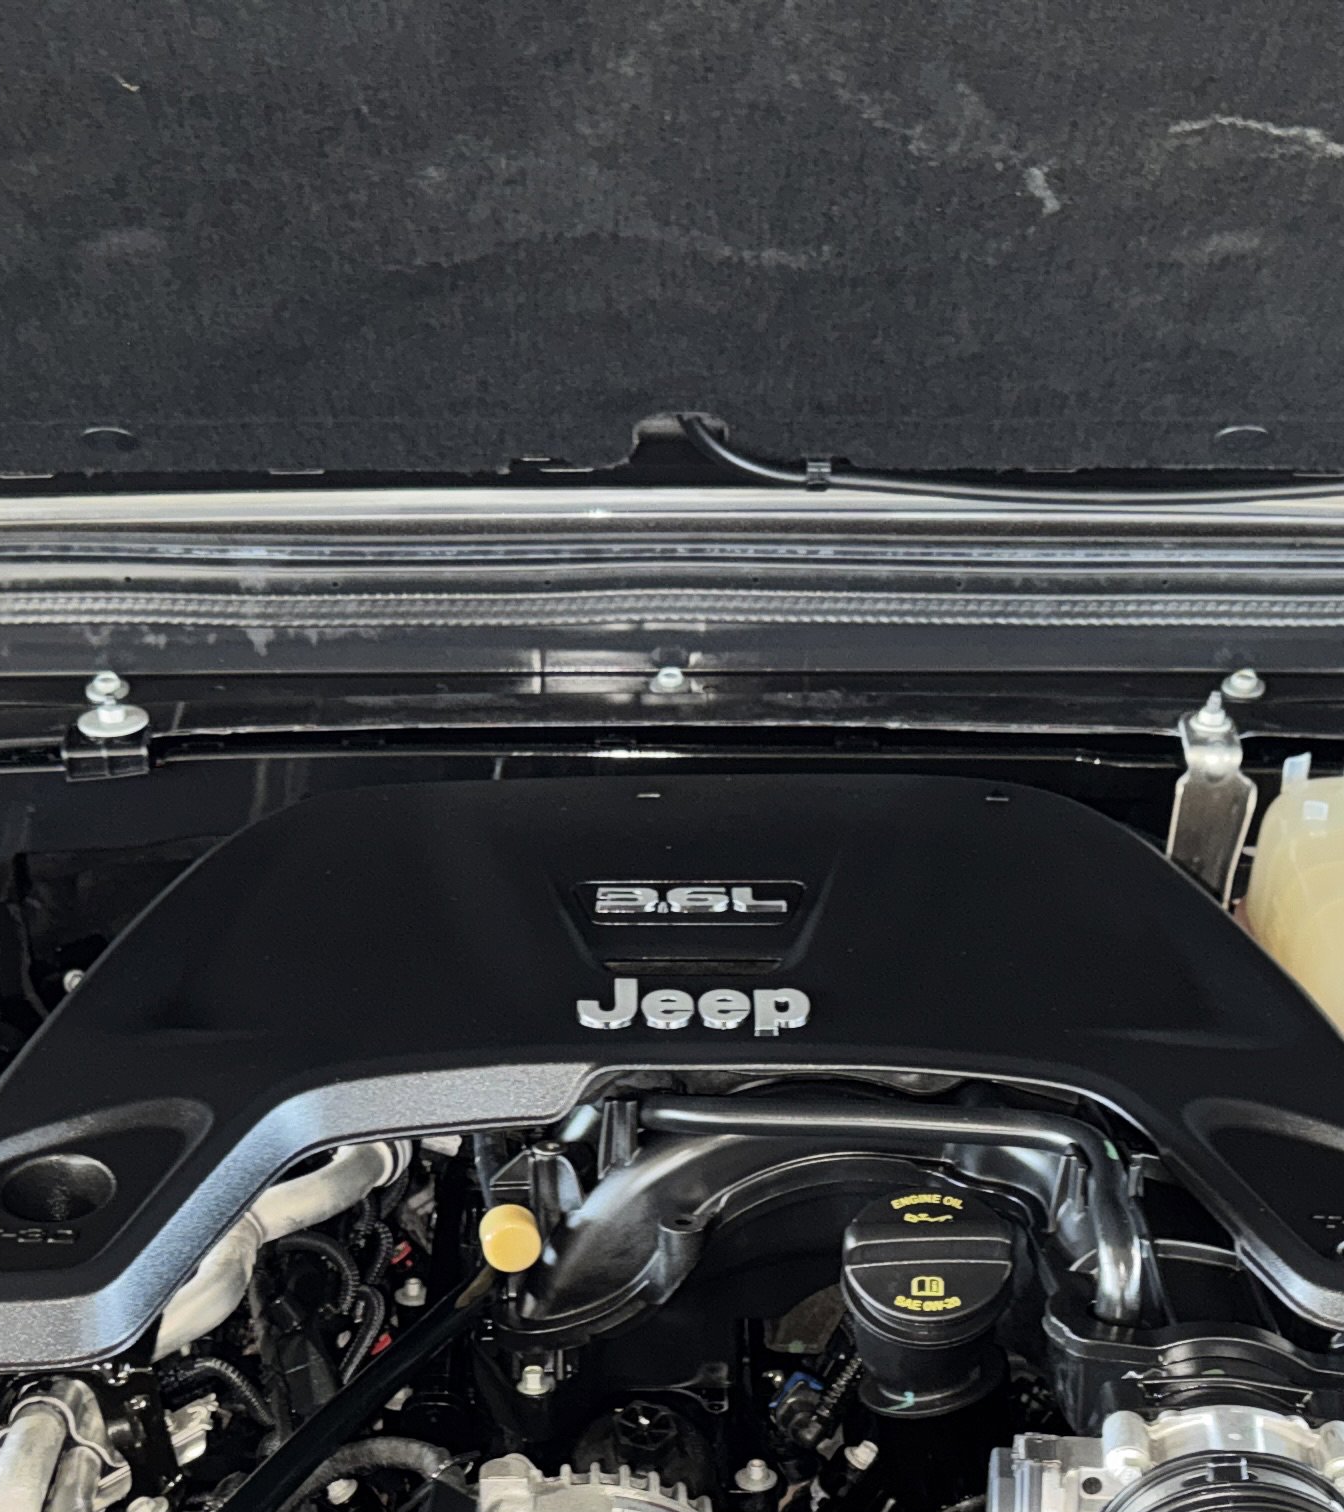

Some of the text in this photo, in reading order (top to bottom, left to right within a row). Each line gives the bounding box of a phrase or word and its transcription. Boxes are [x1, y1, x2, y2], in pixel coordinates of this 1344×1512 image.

[594, 887, 788, 914] 3.6L
[576, 978, 811, 1037] Jeep
[891, 1194, 964, 1210] ENGINE OIL
[893, 1296, 962, 1312] SAE 0W-20
